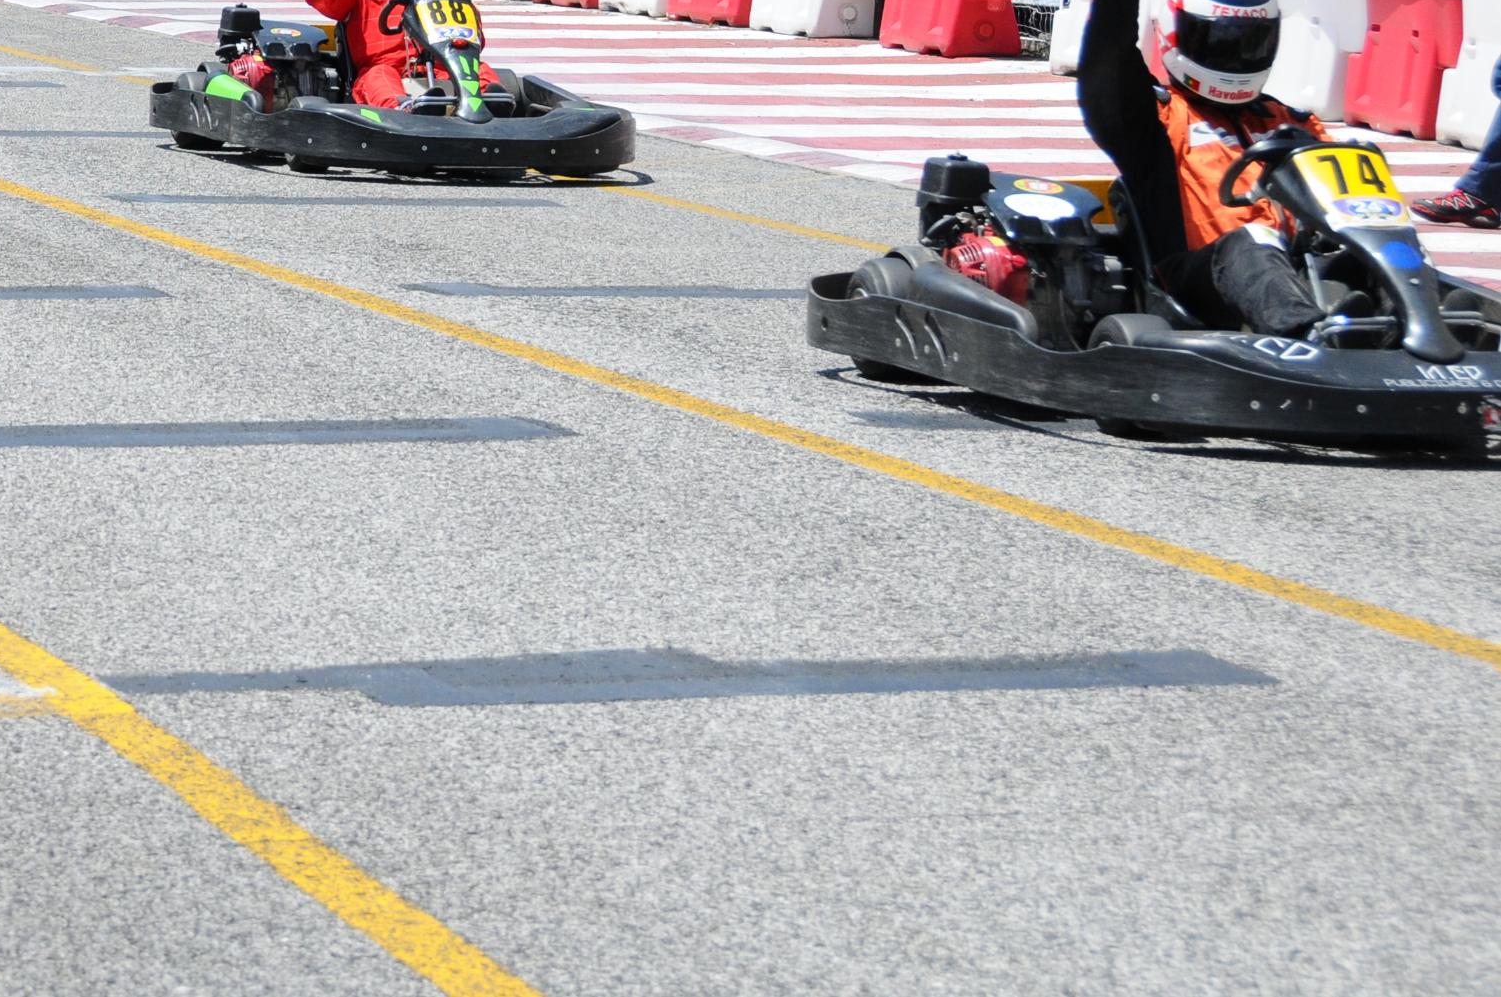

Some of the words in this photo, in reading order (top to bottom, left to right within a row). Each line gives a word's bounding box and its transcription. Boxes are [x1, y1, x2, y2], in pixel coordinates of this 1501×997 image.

[427, 0, 468, 26] 88
[1211, 4, 1268, 19] TEXACO
[1316, 153, 1387, 195] 74
